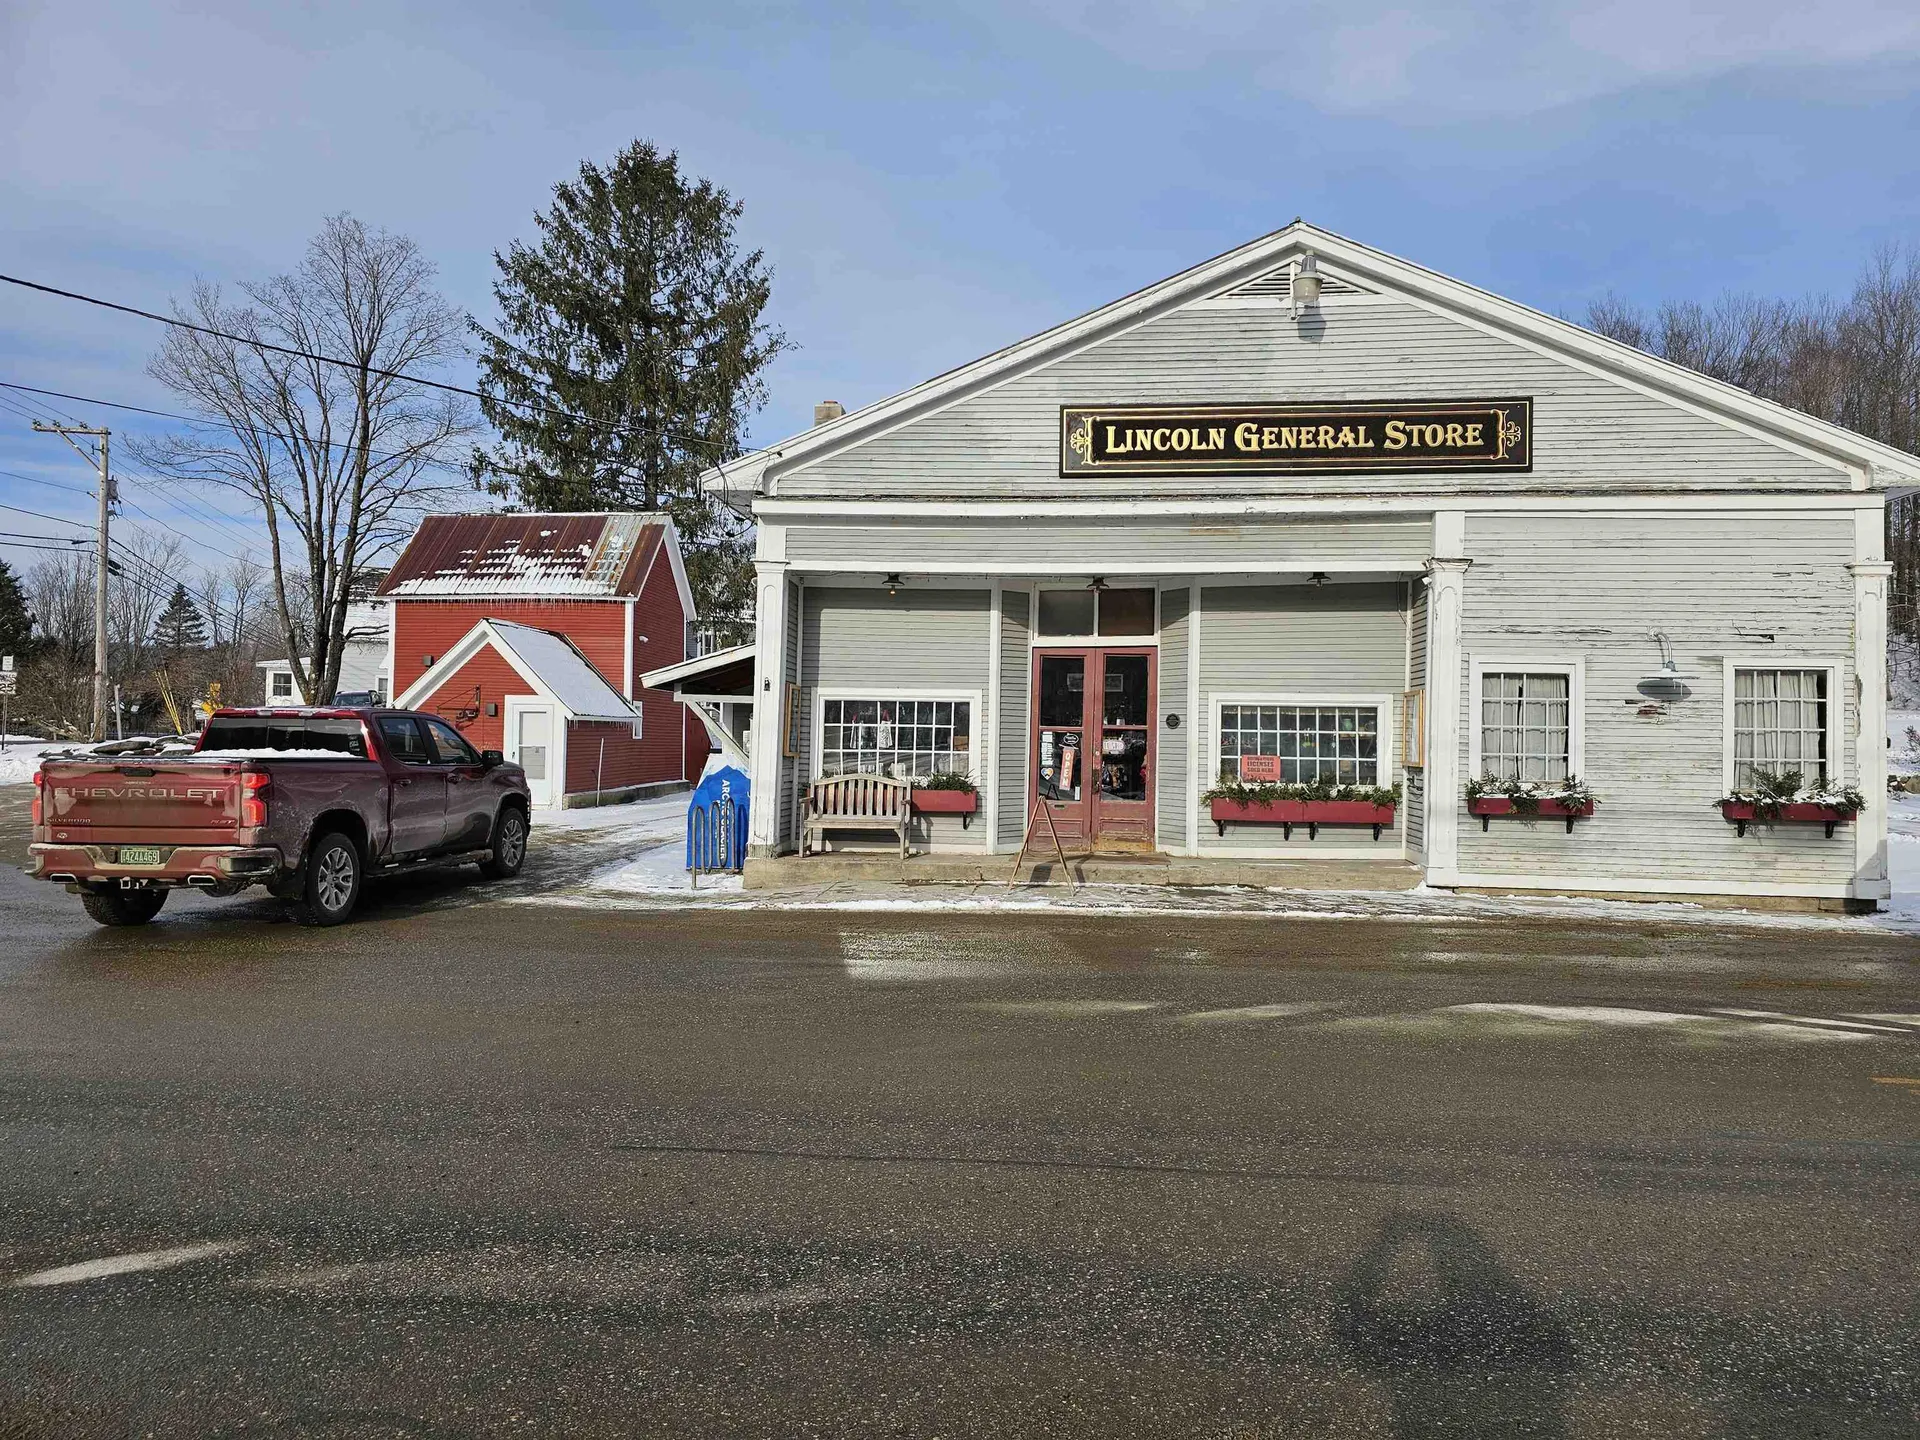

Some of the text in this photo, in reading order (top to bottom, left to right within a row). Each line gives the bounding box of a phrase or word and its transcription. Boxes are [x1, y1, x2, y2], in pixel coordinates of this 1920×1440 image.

[1105, 420, 1485, 454] LINCOLN GENERAL STORE
[1061, 752, 1072, 788] OPEN
[54, 787, 224, 799] CHEVROLET
